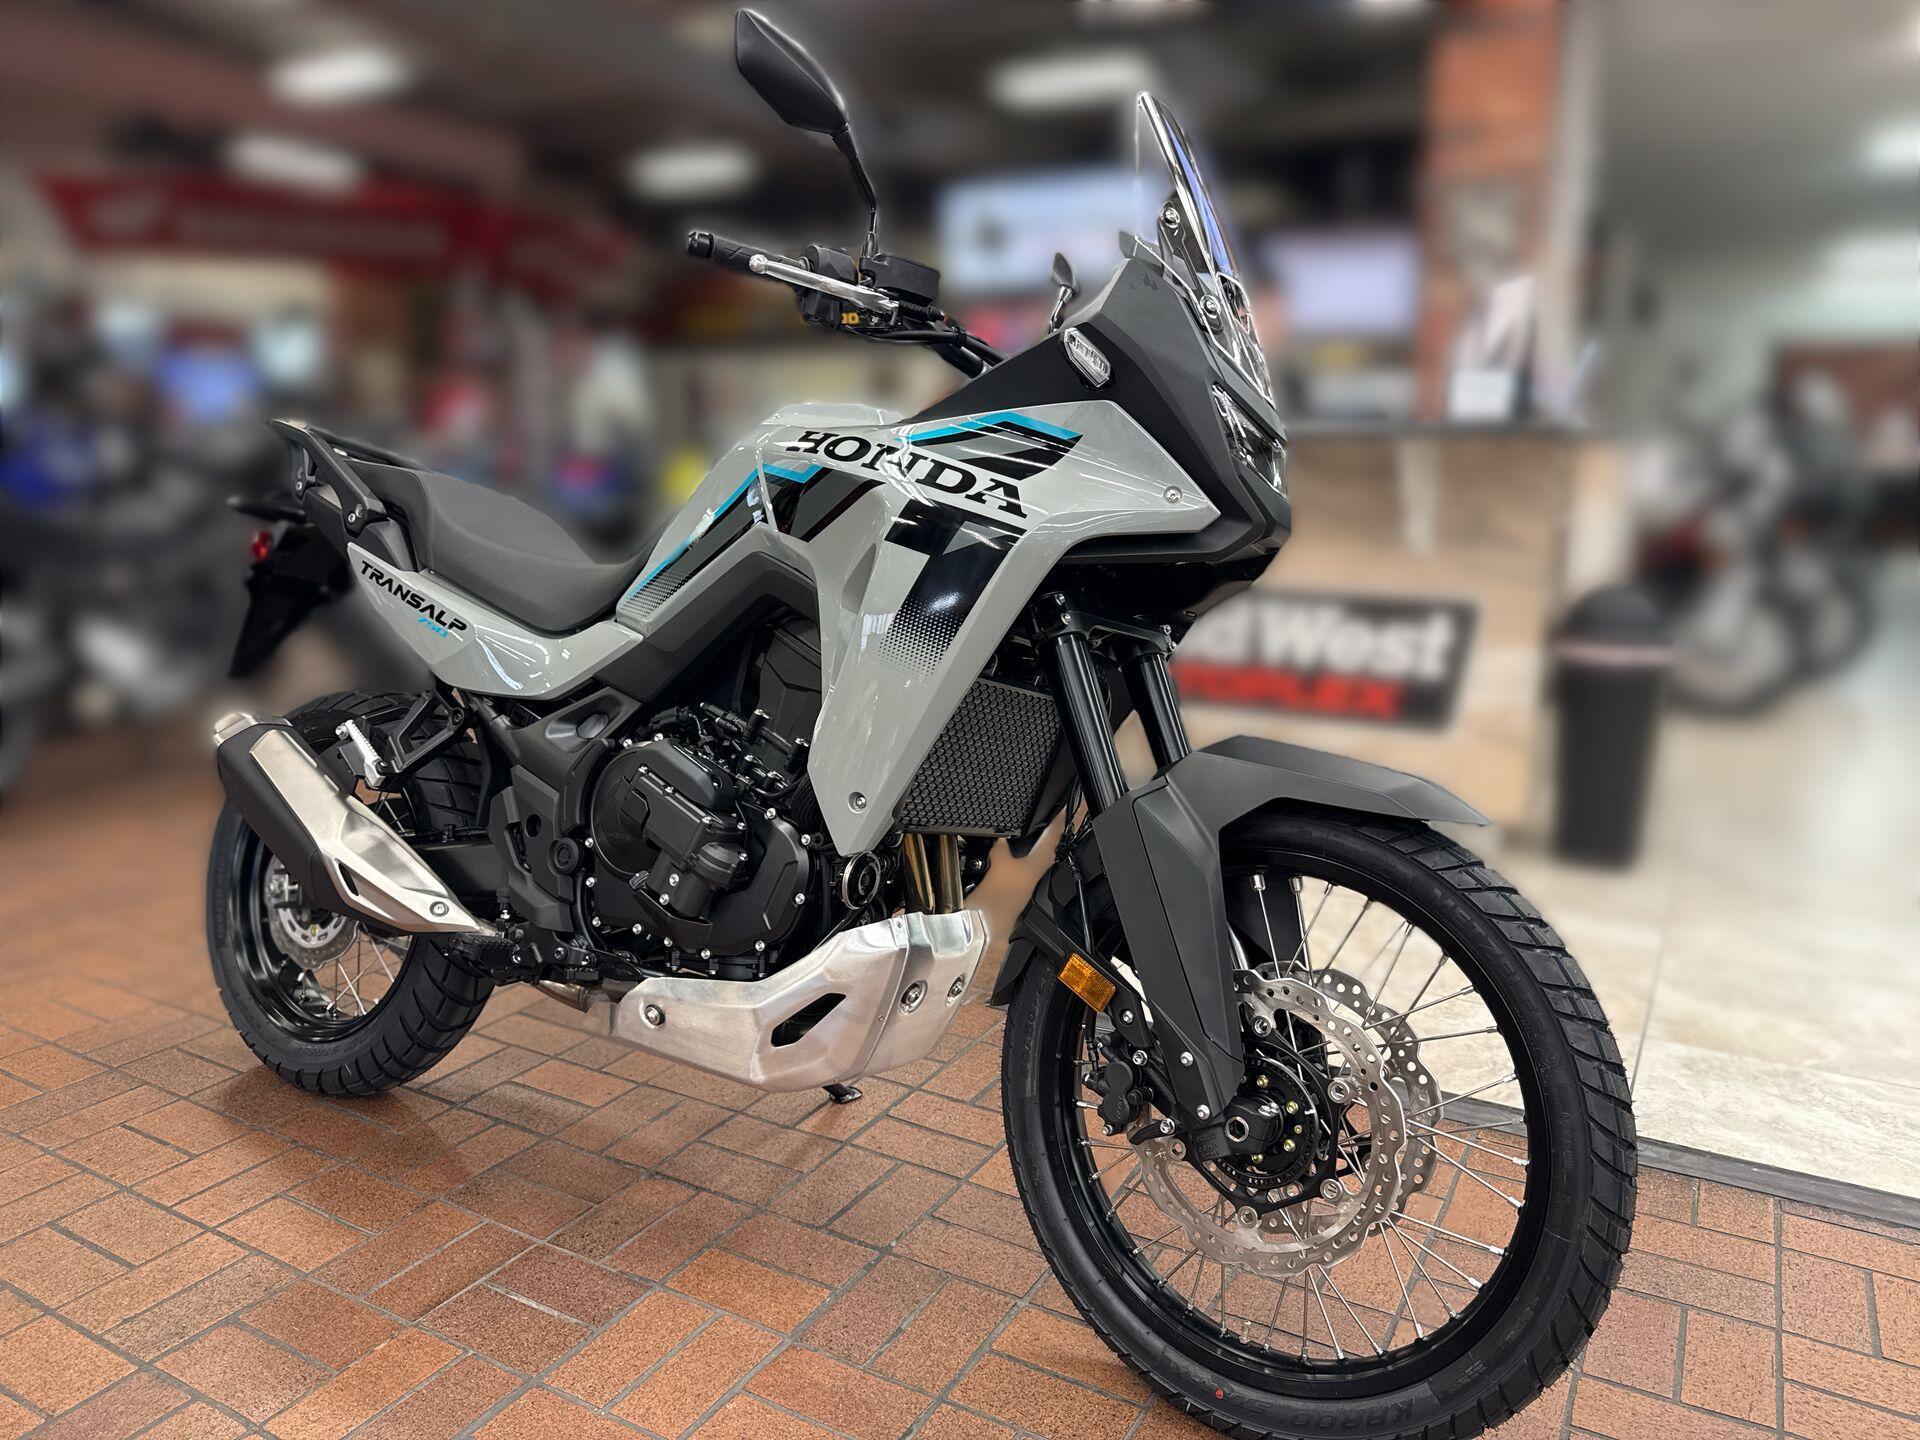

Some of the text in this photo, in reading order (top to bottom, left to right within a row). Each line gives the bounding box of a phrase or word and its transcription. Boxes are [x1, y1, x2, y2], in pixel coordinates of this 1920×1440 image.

[784, 430, 1028, 519] HONDA
[361, 560, 467, 633] TRANSALP
[1257, 600, 1451, 681] West
[1430, 887, 1553, 1038] METZELER
